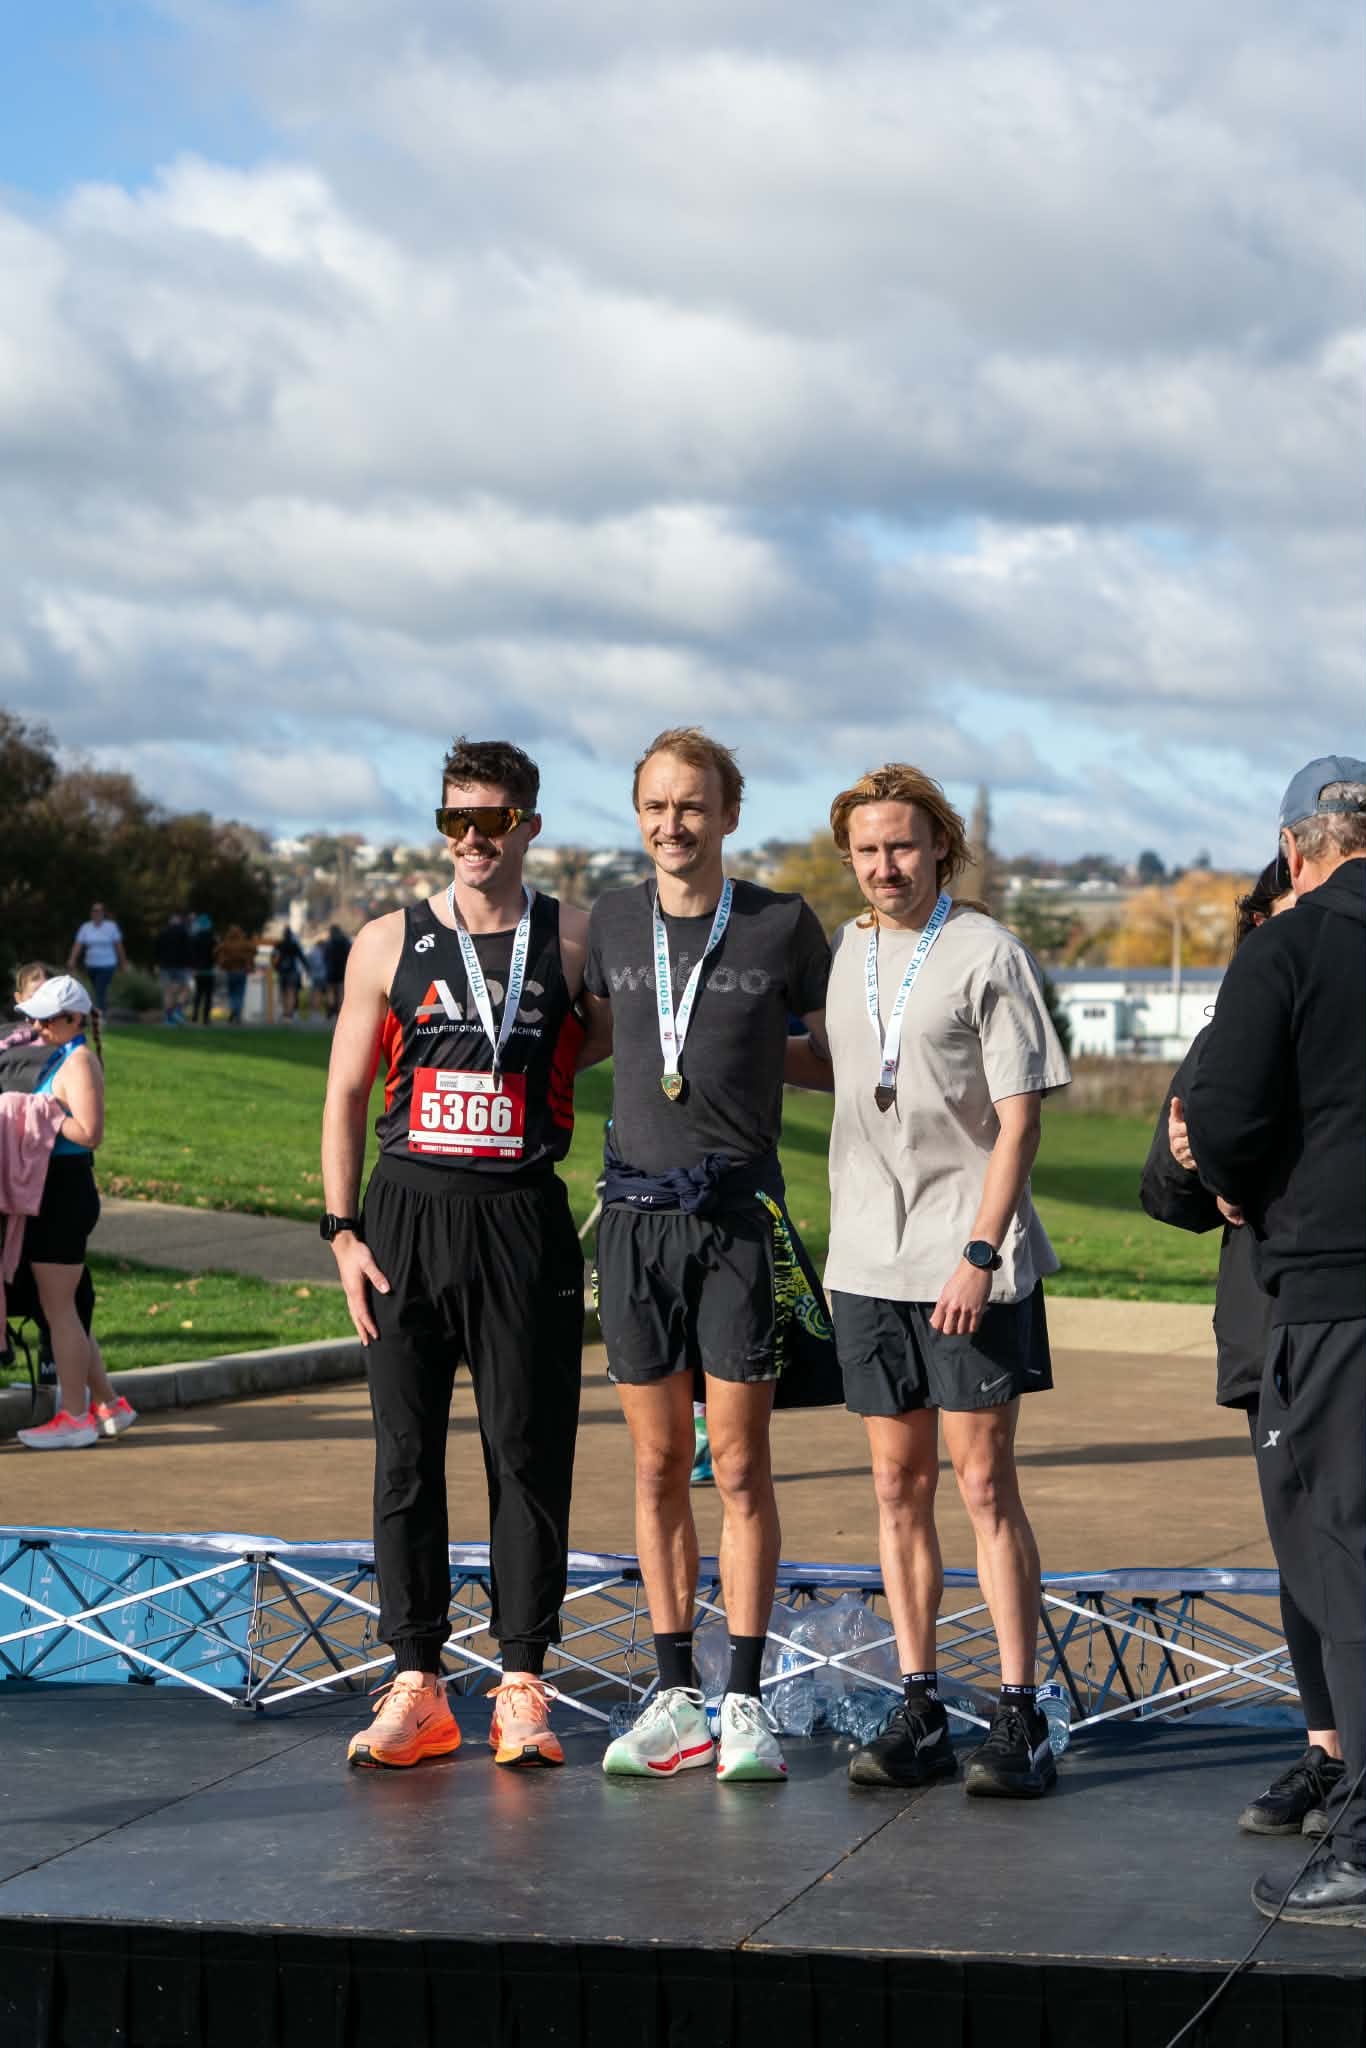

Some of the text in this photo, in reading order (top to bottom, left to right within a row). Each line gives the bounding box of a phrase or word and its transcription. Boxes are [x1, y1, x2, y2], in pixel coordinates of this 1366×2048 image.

[461, 936, 485, 998] ATHLETICS
[510, 941, 525, 1000] TASMANIA
[656, 925, 670, 1015] ALL SCHOOLS
[894, 896, 950, 1016] ATHLETICS TASMANIA
[415, 979, 545, 1024] APC
[420, 1091, 513, 1134] 5366
